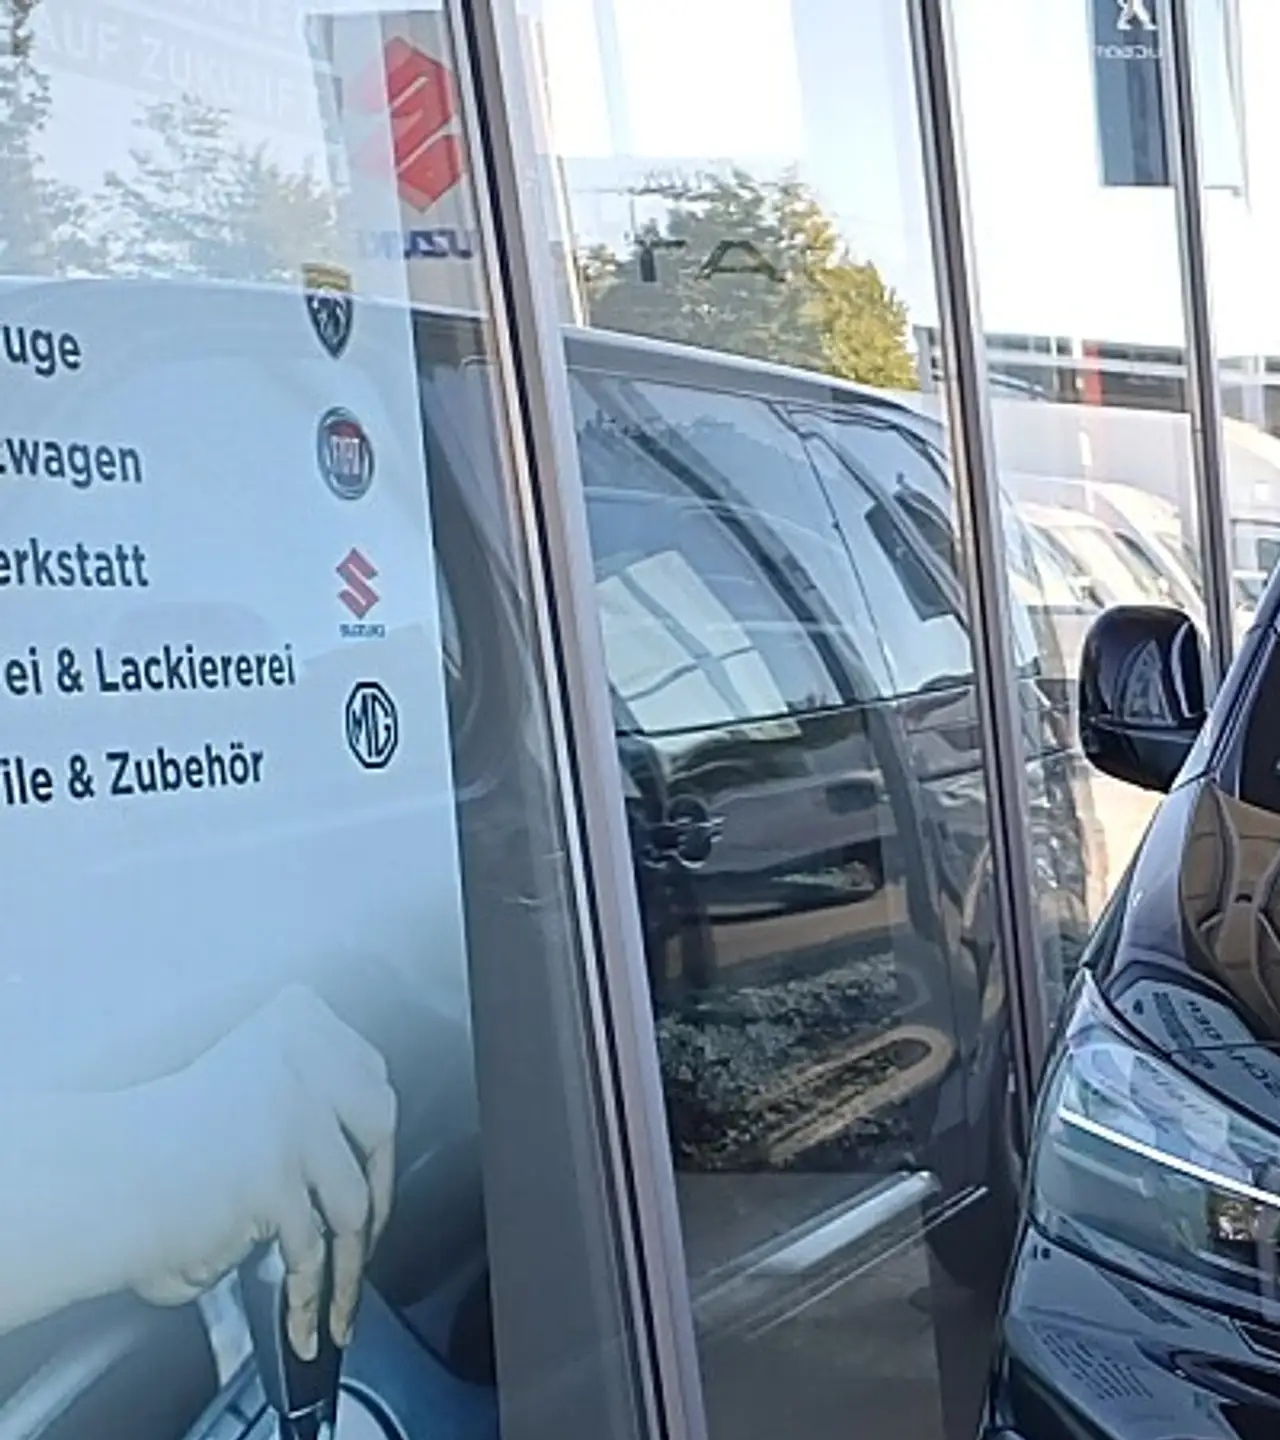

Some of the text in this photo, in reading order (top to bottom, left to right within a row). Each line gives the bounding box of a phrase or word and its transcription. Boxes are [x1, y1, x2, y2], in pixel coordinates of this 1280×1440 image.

[5, 643, 296, 697] ei & Lackiererei
[350, 690, 394, 761] MG
[69, 755, 94, 799] &
[105, 742, 264, 797] Zubehör
